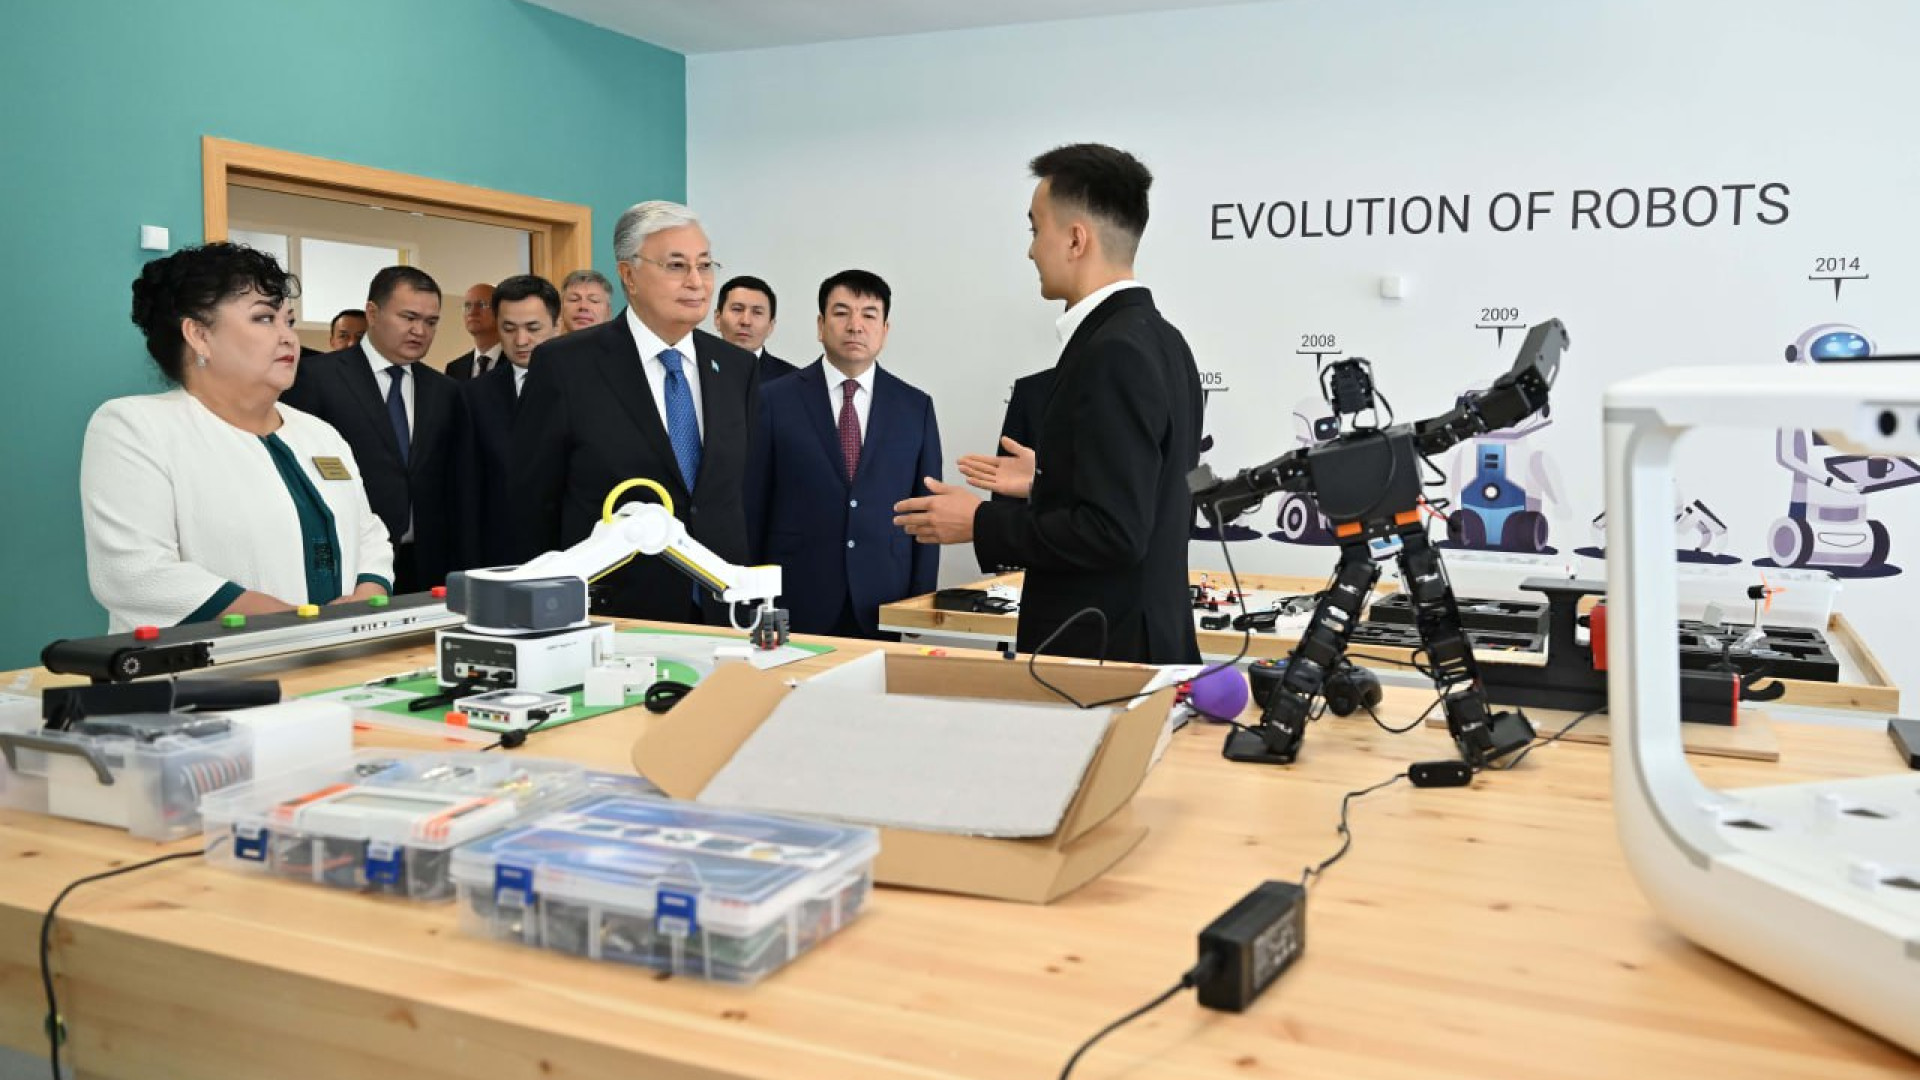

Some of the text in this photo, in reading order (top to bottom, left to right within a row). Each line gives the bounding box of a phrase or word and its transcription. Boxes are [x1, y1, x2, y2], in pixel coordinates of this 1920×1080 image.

[1211, 182, 1791, 241] EVOLUTION OF ROBOTS
[1815, 257, 1861, 272] 2014
[1481, 307, 1519, 322] 2009
[1301, 334, 1336, 348] 2008
[1199, 371, 1222, 385] 005
